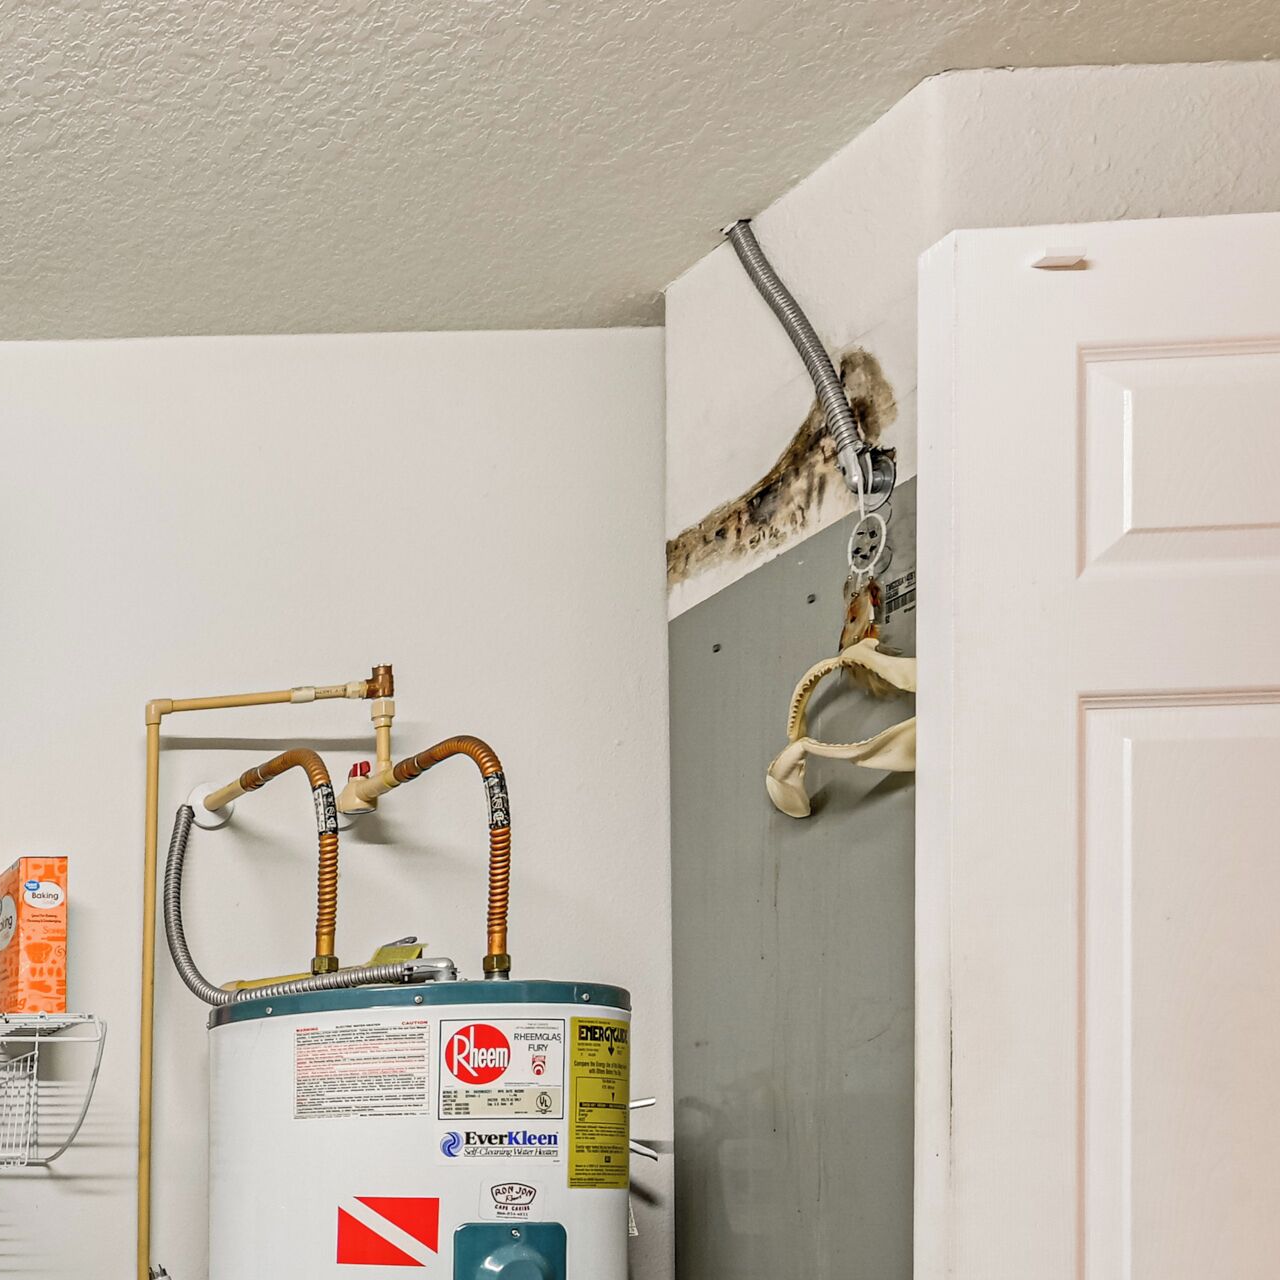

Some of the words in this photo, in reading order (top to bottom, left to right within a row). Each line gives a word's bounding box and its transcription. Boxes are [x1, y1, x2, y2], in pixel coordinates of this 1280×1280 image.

[31, 892, 59, 900] Baking
[514, 1033, 561, 1041] RHEEMGLAS
[453, 1026, 508, 1077] Rheem
[464, 1131, 558, 1145] EverKleen
[464, 1148, 513, 1157] Self-Cleaning
[495, 1186, 513, 1196] RON
[515, 1187, 534, 1197] JON
